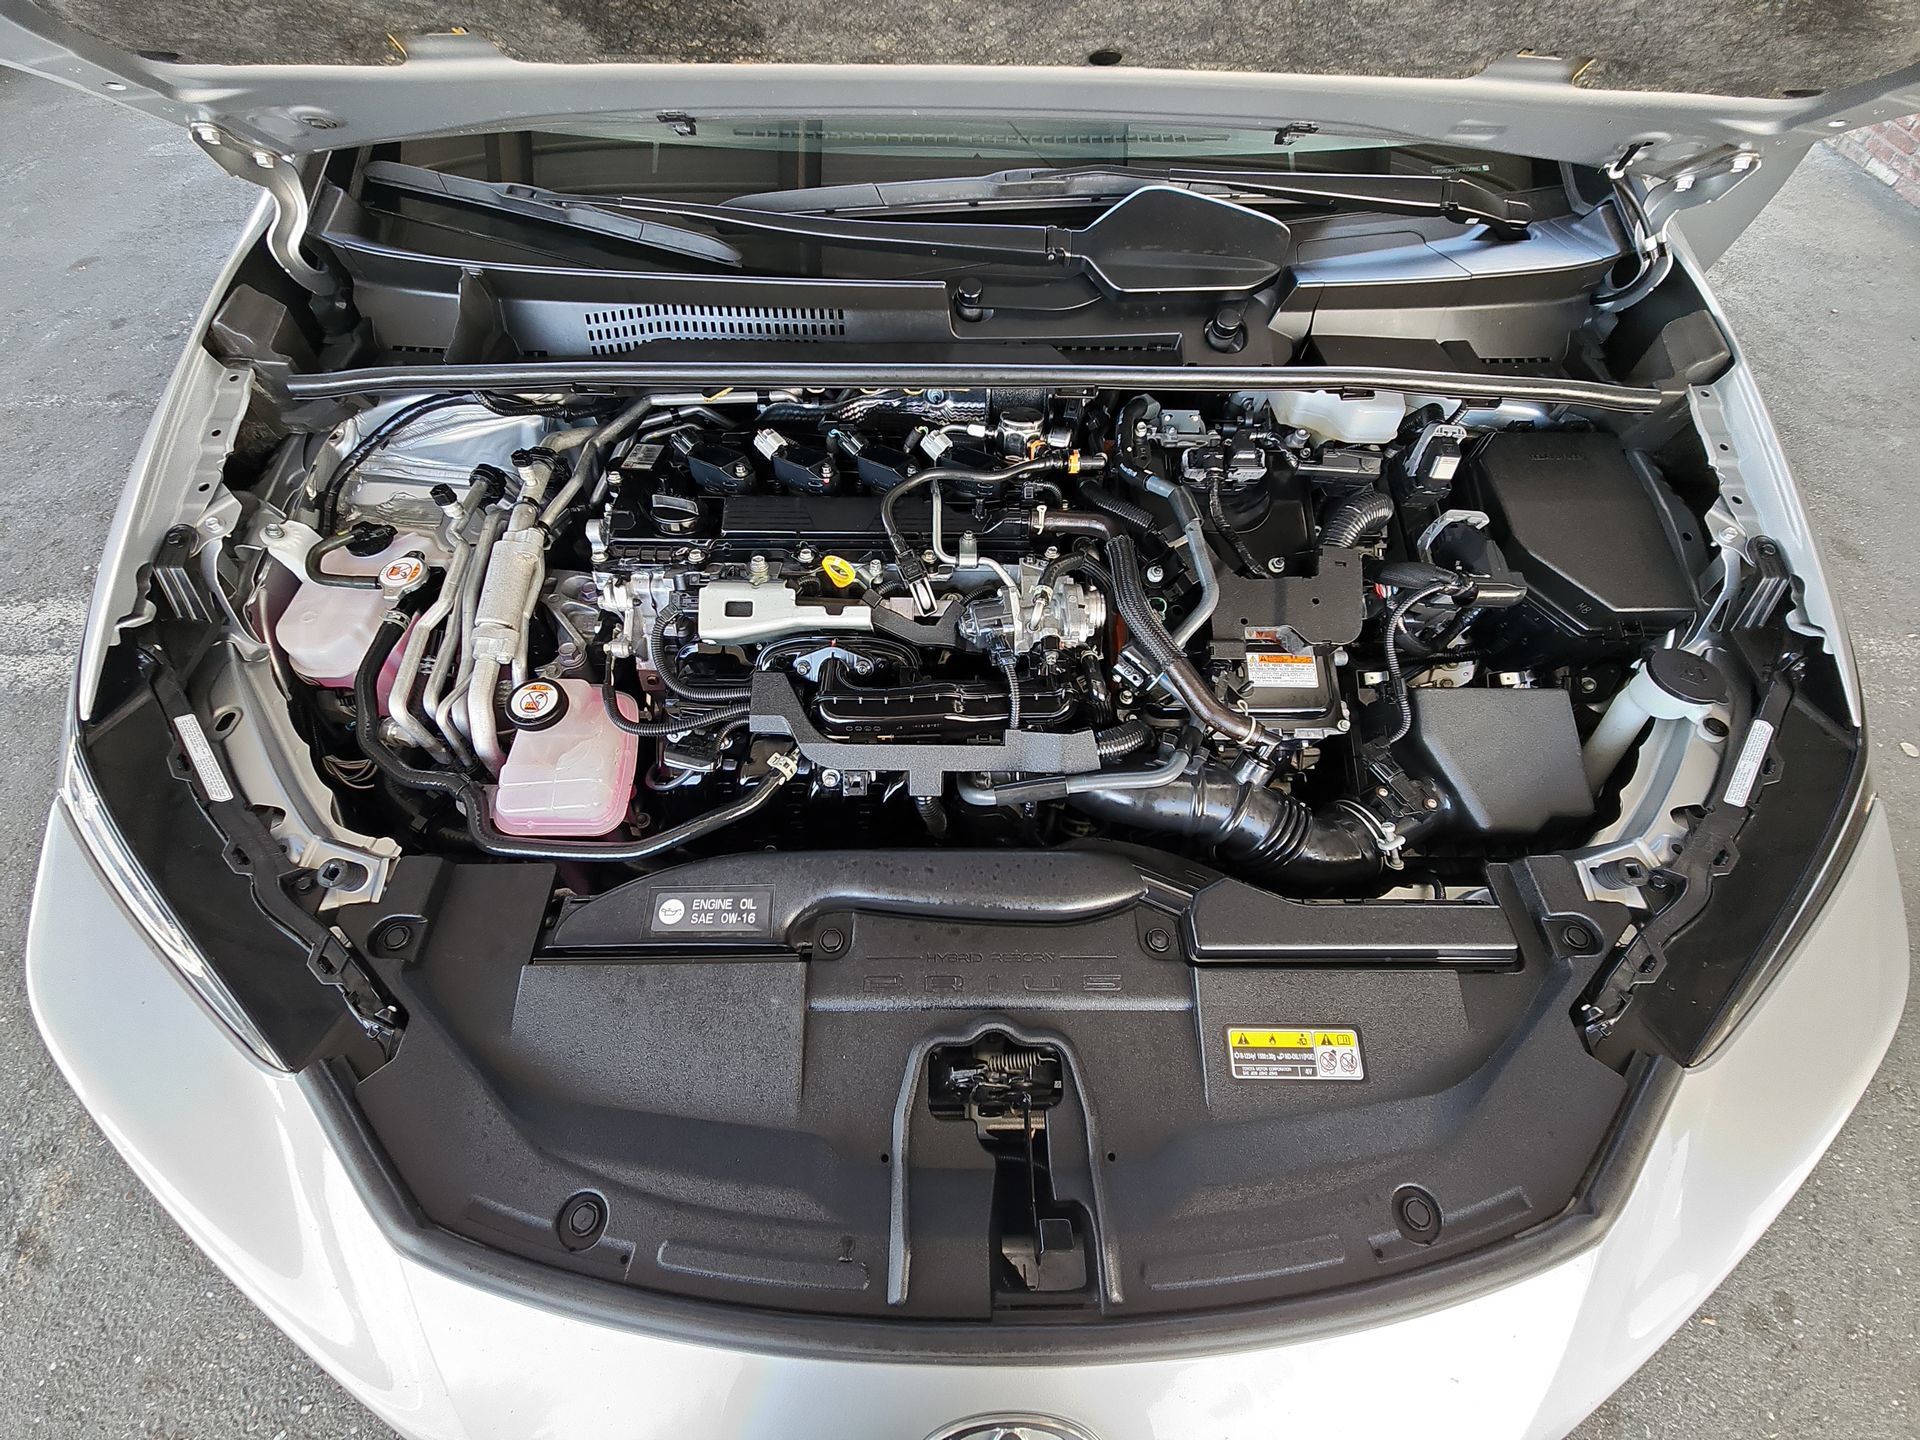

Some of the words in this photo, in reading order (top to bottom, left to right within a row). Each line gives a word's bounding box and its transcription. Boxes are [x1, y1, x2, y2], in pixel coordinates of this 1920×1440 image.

[692, 898, 733, 910] ENGINE
[739, 898, 757, 910] OIL
[690, 912, 714, 924] SAE
[720, 912, 756, 924] 0W-16
[926, 951, 983, 963] HYBRID
[991, 951, 1056, 963] REBORN
[862, 974, 1123, 992] PRIUS
